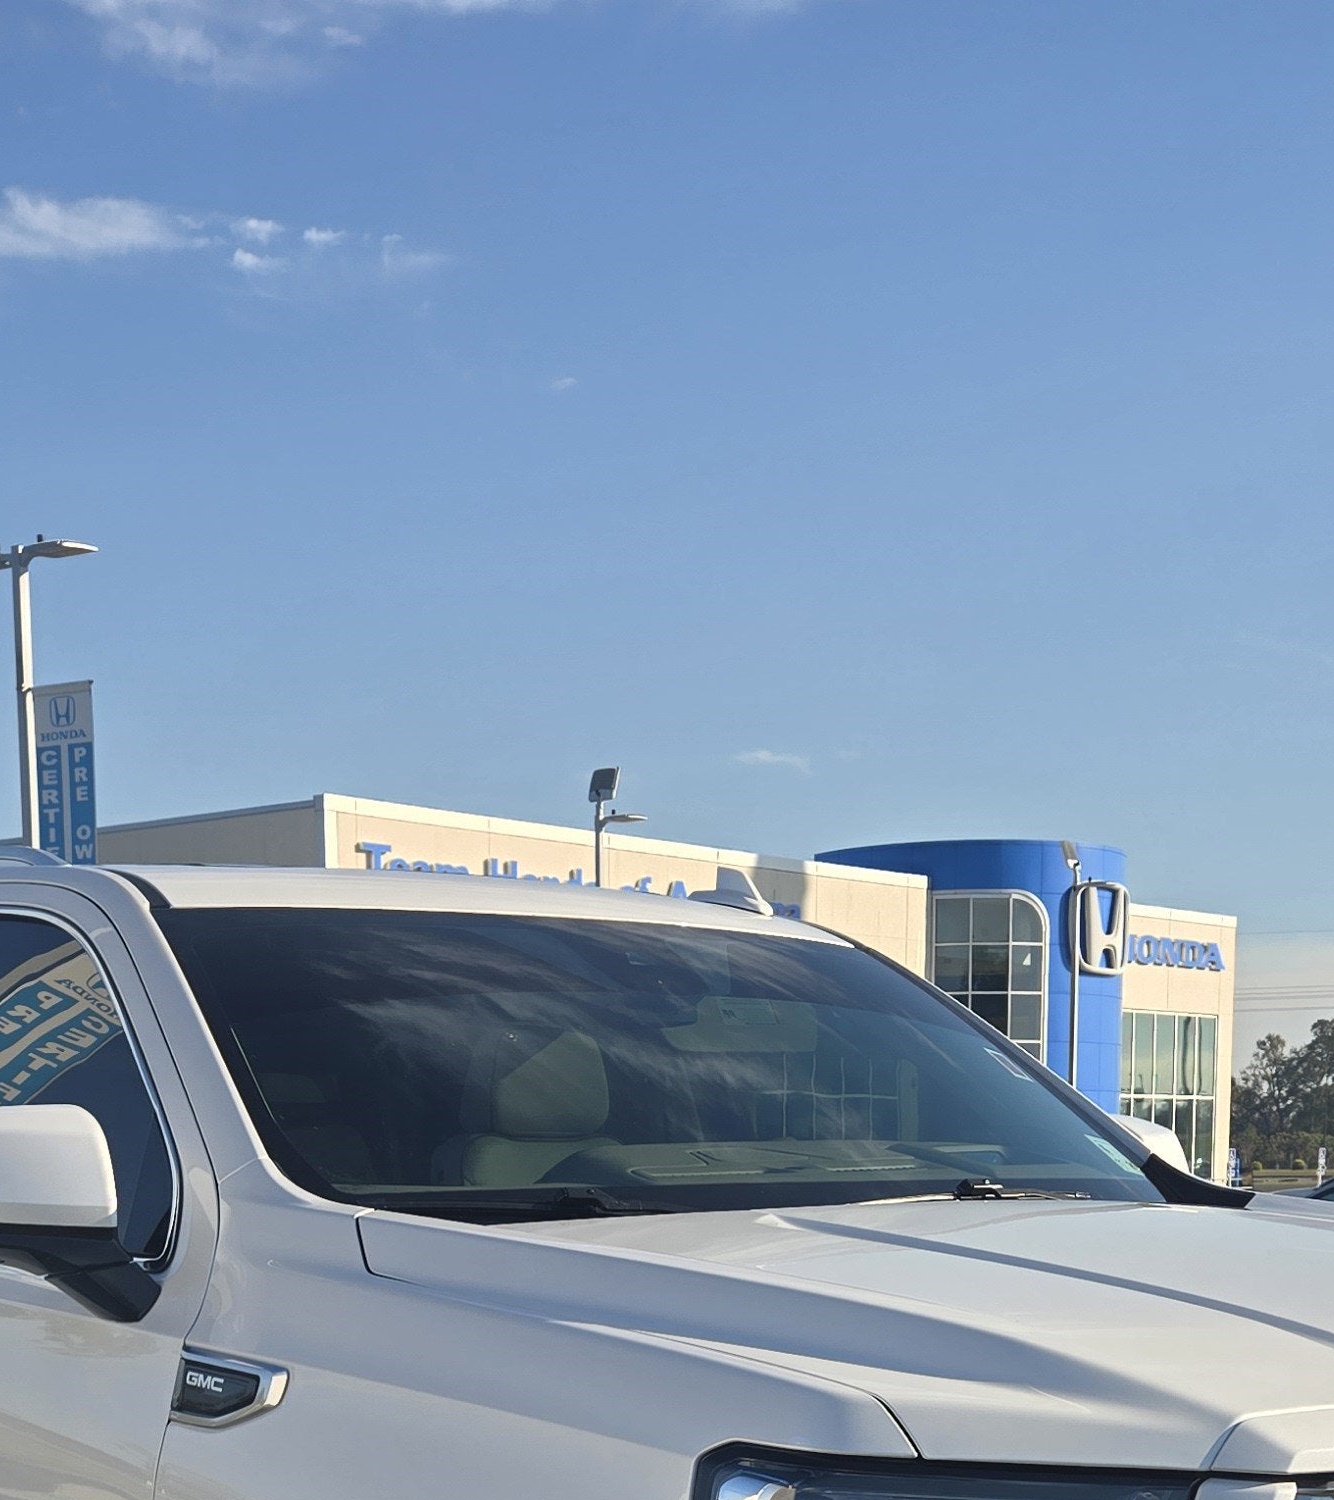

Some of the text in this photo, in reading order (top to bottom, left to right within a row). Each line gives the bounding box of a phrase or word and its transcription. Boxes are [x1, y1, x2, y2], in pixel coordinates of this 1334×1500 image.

[40, 728, 87, 742] HONDA
[74, 747, 94, 865] PRE OW
[186, 1371, 224, 1393] GMC
